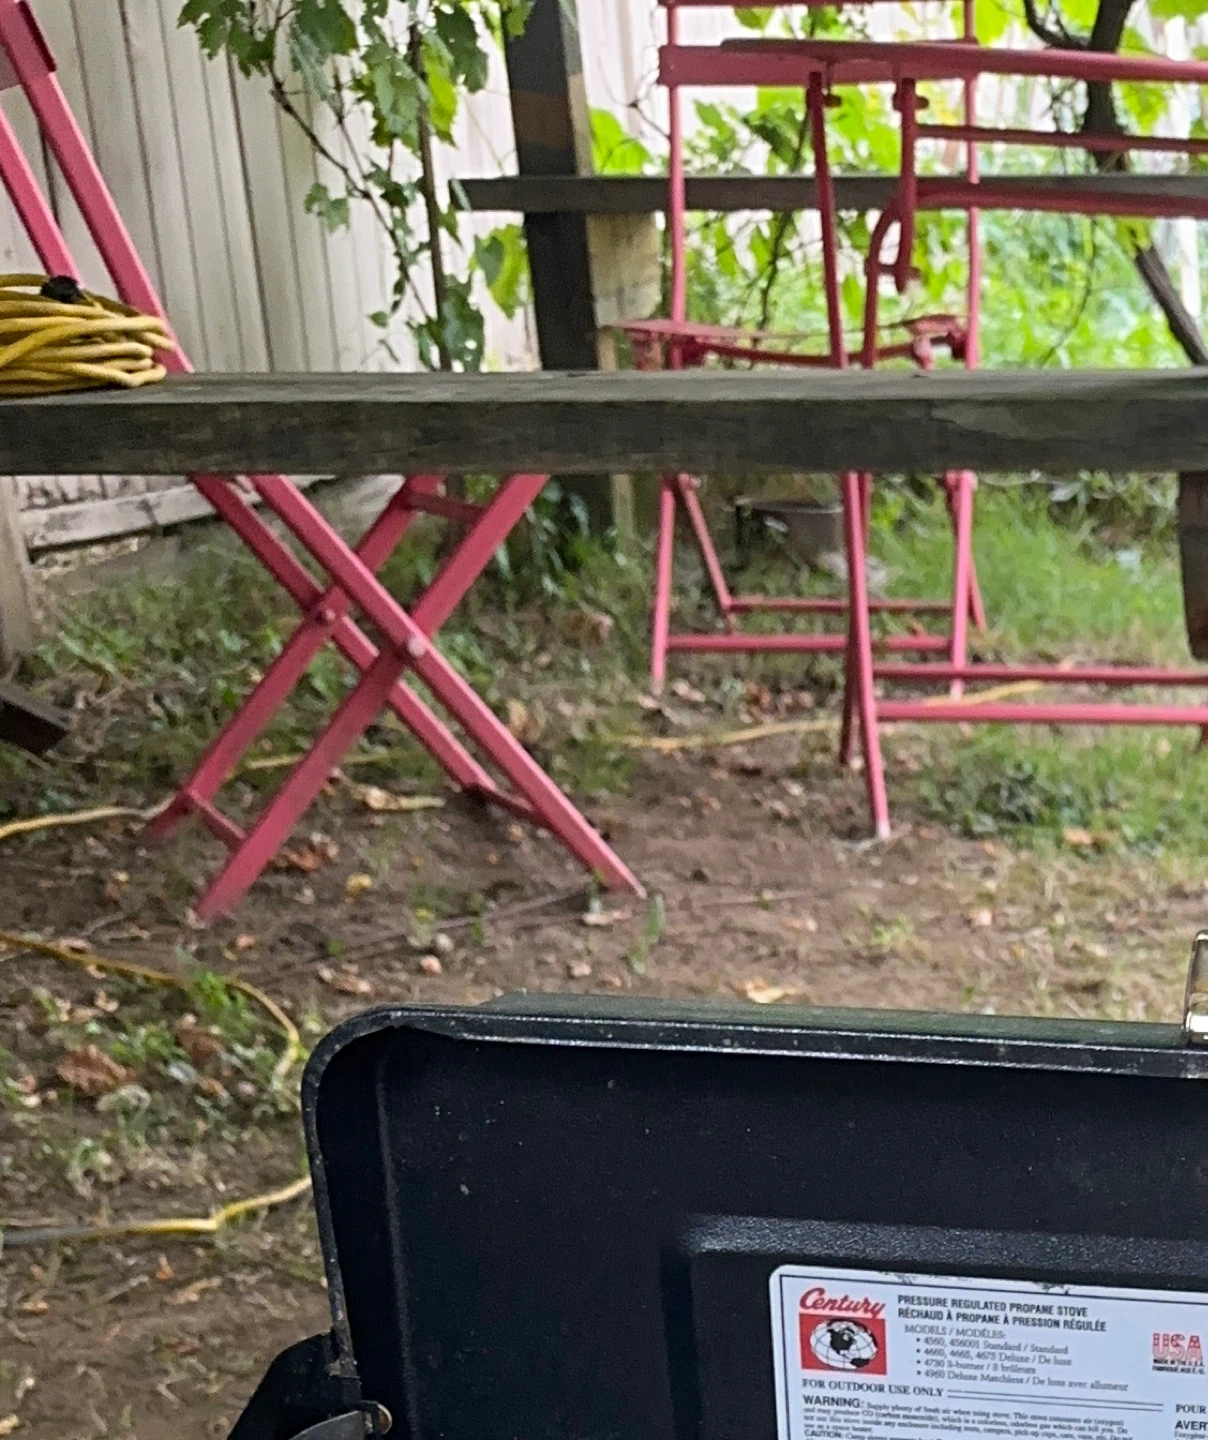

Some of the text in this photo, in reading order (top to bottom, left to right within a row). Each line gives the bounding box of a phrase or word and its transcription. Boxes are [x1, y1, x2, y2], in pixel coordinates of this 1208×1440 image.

[800, 1287, 886, 1319] Century
[897, 1294, 1088, 1318] PRESSURE REGULATED PROPANE STOVE
[898, 1307, 1106, 1332] RÉCHAUD À PROPANE À PRESSION RÉGULÉE
[1153, 1332, 1203, 1361] USA
[802, 1378, 943, 1397] FOR OUTDOOR USE ONLY
[803, 1396, 868, 1409] WARNING:
[1175, 1404, 1206, 1414] POUR
